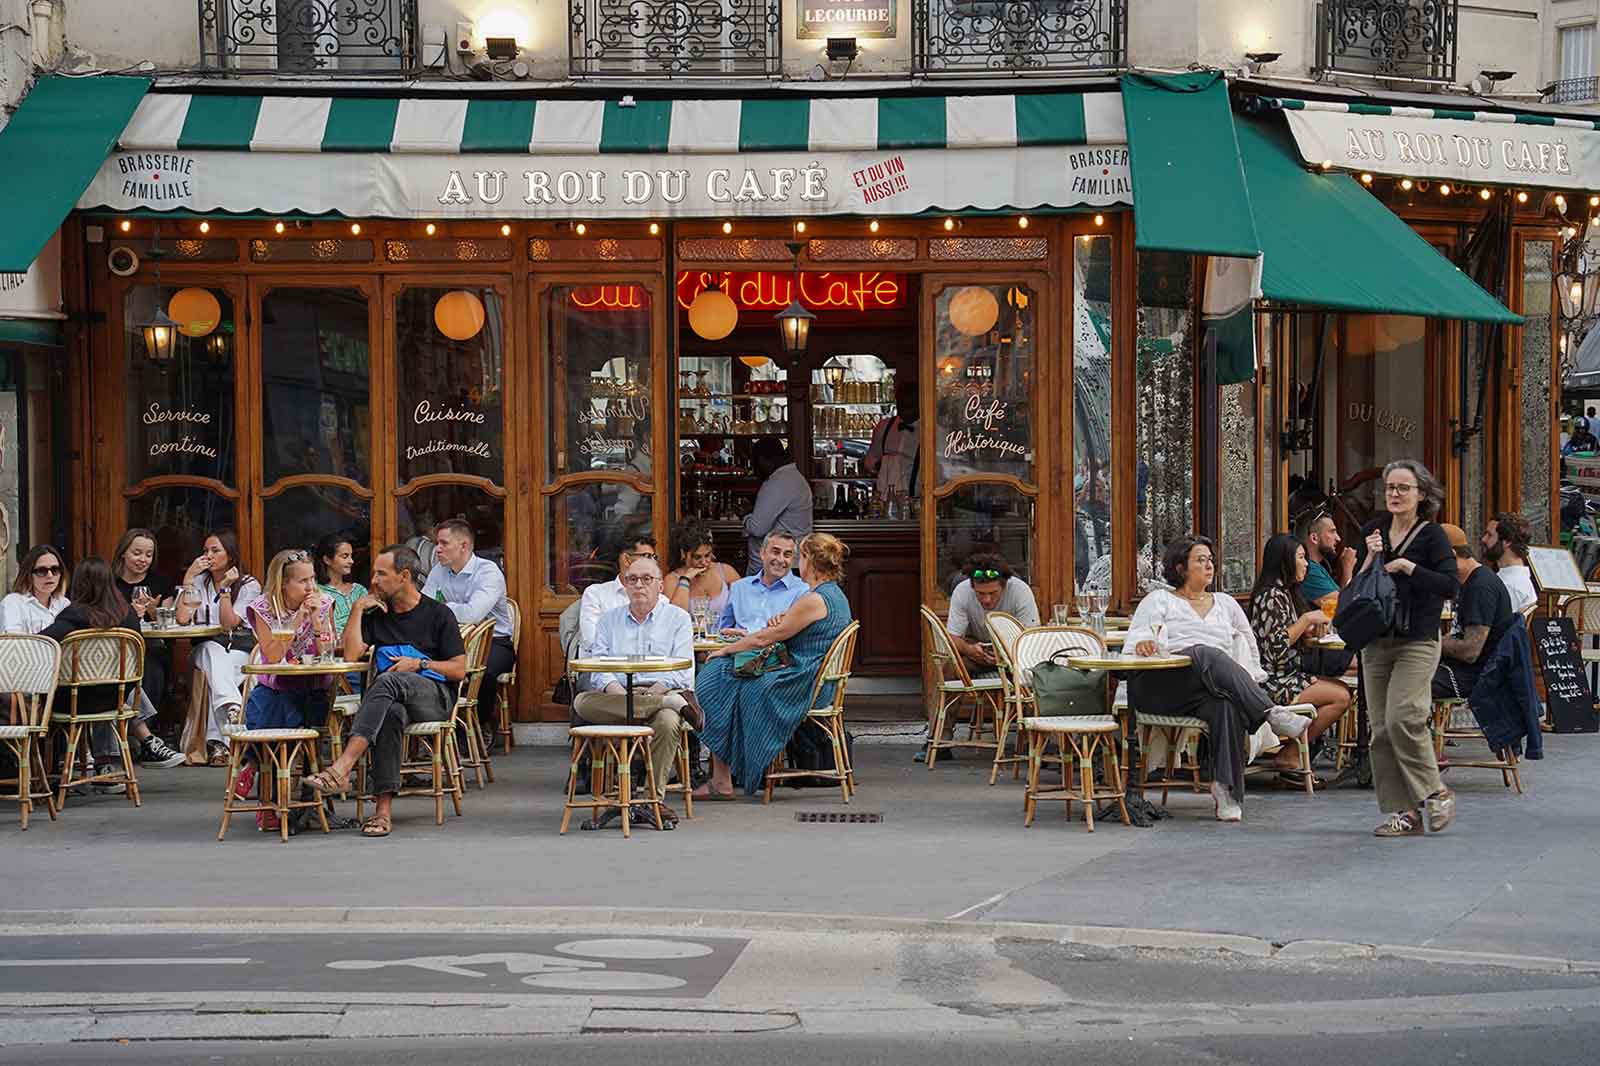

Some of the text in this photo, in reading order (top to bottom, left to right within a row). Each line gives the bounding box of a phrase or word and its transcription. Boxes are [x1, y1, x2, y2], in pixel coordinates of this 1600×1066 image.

[805, 8, 889, 23] LECOURBE
[1070, 149, 1129, 170] BRASSER
[1345, 127, 1572, 175] AU ROI DU CAFÉ
[118, 153, 194, 175] BRASSERIE
[852, 155, 905, 188] ET DU VIN
[122, 180, 192, 200] FAMILIALE
[438, 161, 830, 205] AU ROI DU CAFÉ
[863, 179, 896, 205] AUSSI
[1071, 176, 1132, 195] FAMILIAL
[740, 271, 793, 306] du
[143, 402, 212, 424] Service
[413, 399, 485, 424] Cuisine
[964, 394, 1008, 431] Café
[1349, 402, 1373, 423] DU
[150, 435, 217, 458] continu
[405, 439, 492, 460] traditionnelle
[944, 430, 1025, 459] Historique
